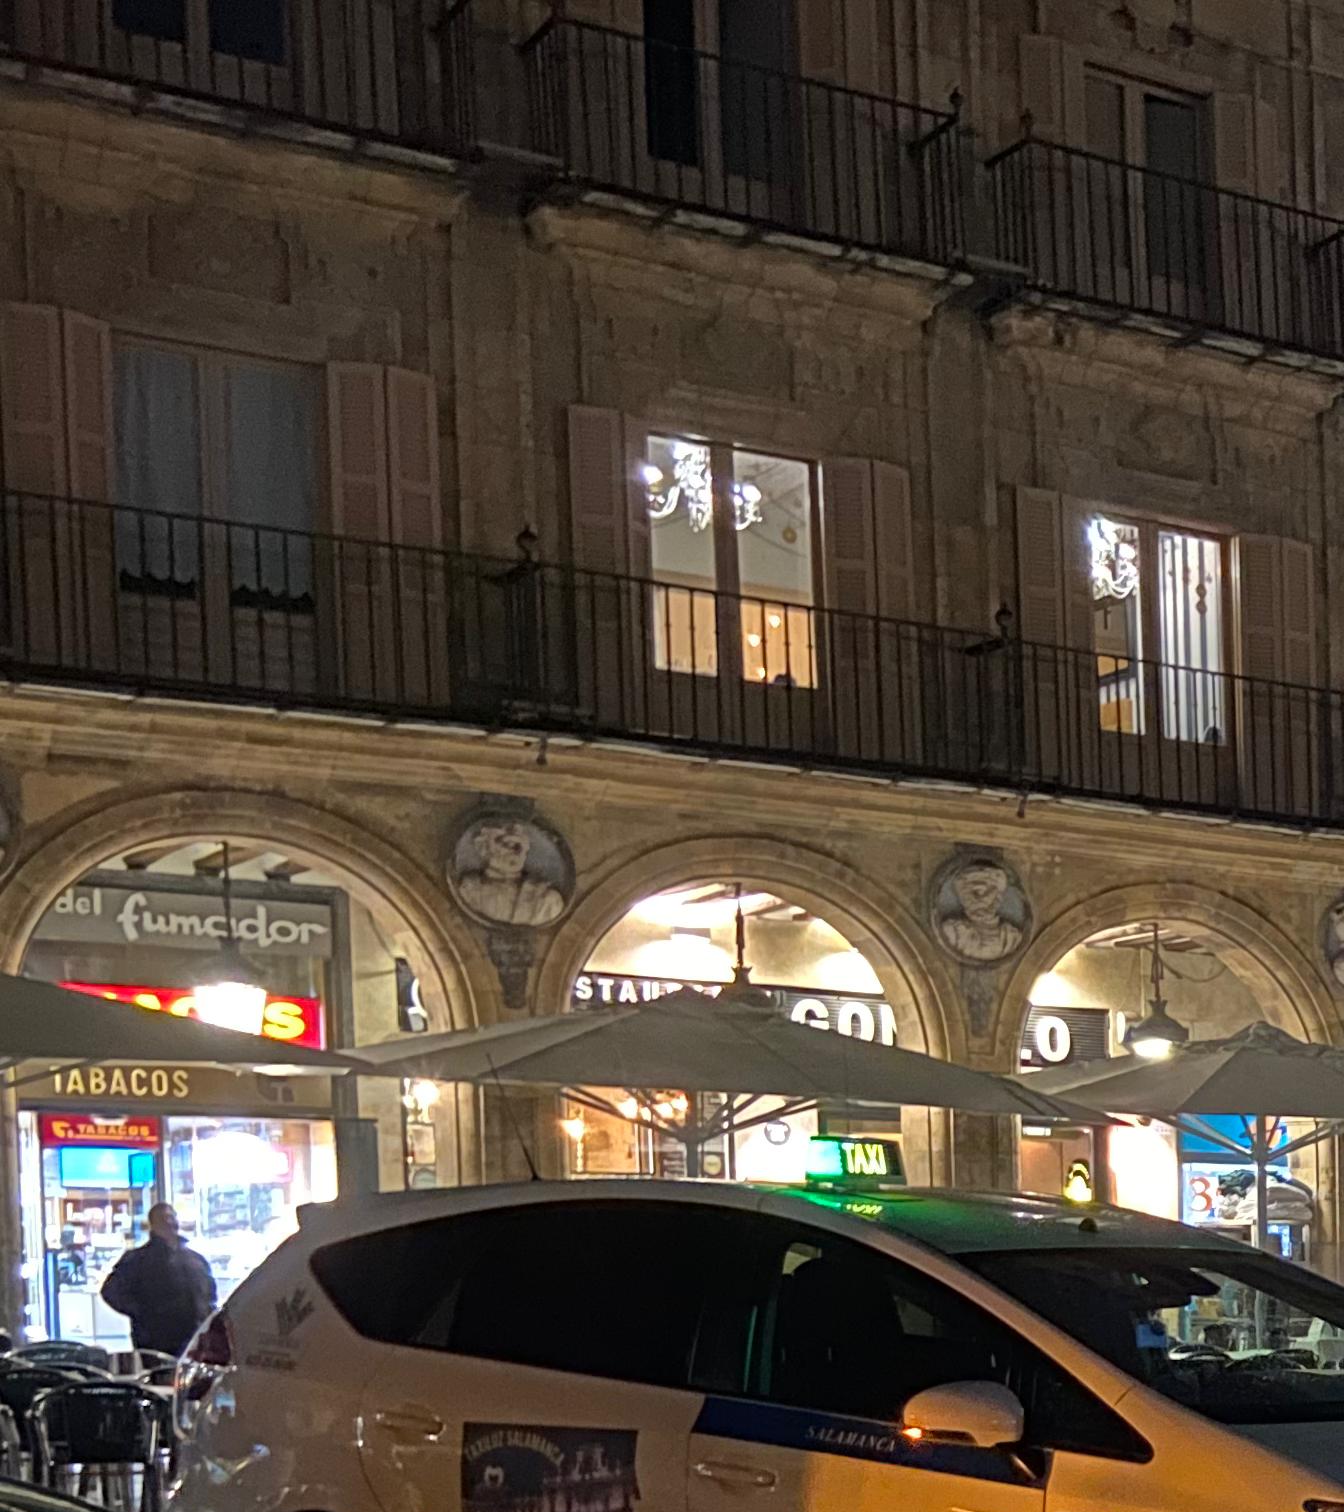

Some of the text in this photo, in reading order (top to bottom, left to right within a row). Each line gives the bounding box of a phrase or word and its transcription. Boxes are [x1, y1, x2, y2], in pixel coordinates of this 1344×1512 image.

[55, 889, 328, 947] del fumador
[842, 1142, 888, 1175] TAXI
[805, 1426, 897, 1452] SALAMANCA
